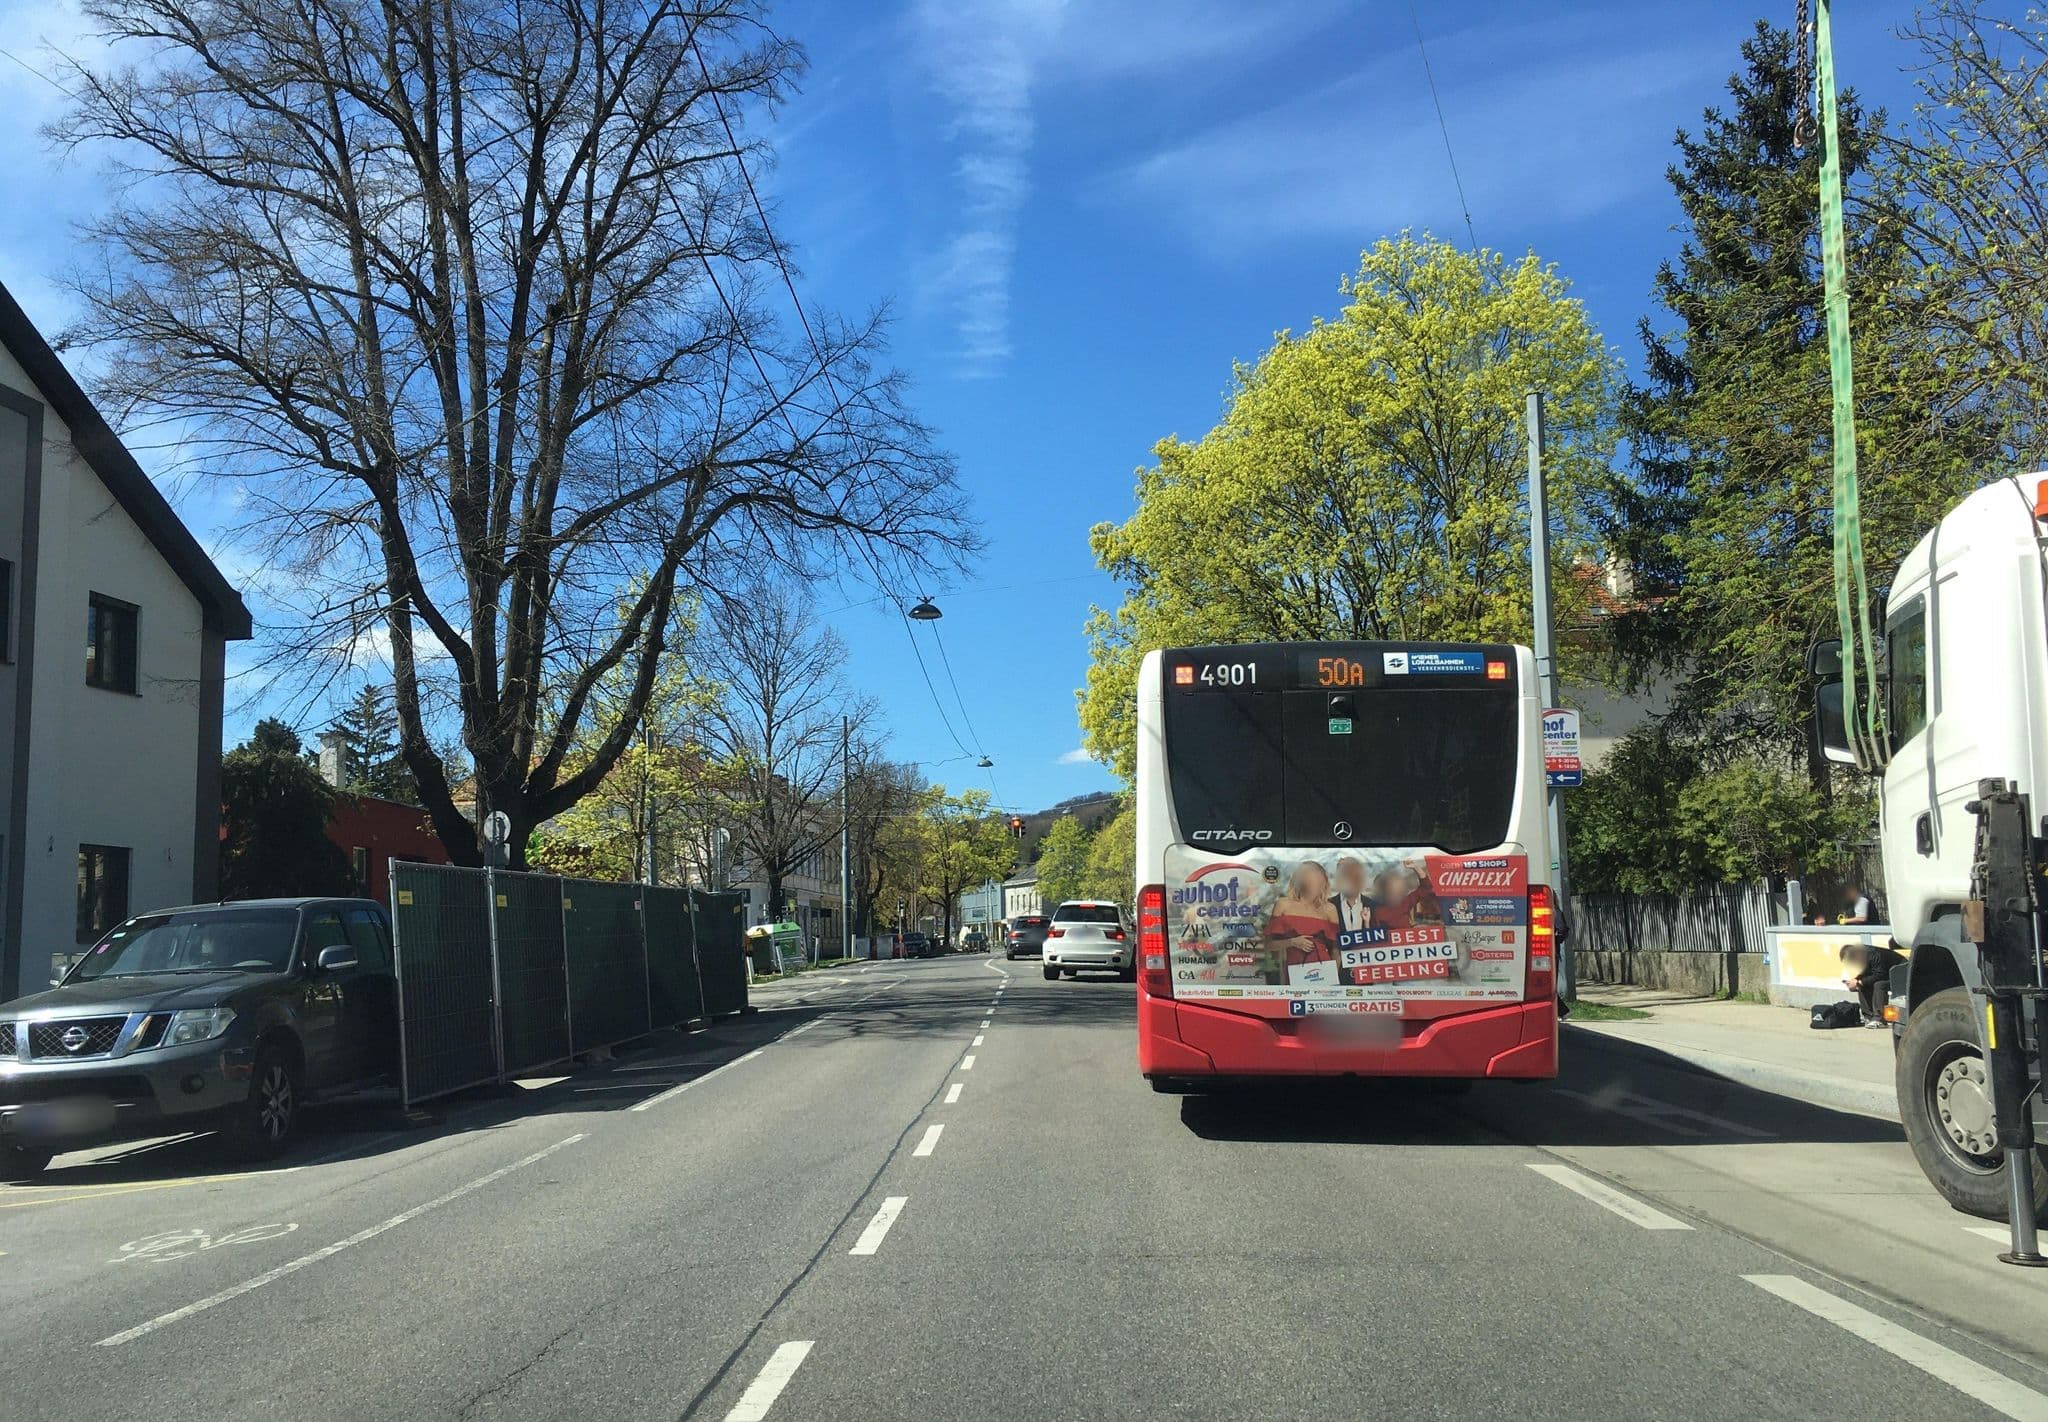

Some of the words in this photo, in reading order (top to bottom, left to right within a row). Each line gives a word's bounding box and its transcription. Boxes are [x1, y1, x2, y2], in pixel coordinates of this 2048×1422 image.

[1200, 663, 1257, 686] 4901
[1318, 658, 1364, 686] 50A
[1543, 718, 1564, 731] hof
[1192, 830, 1273, 840] CITARO
[1438, 868, 1518, 886] CINEPLEXX
[1172, 877, 1239, 904] auhof
[1196, 903, 1262, 917] center
[1224, 941, 1258, 950] ONLY
[1340, 929, 1385, 946] DEIN
[1390, 929, 1440, 944] BEST
[1346, 945, 1452, 964] SHOPPING
[1359, 962, 1445, 980] FEELING
[1307, 1003, 1315, 1013] 3
[1348, 1001, 1401, 1012] GRATIS
